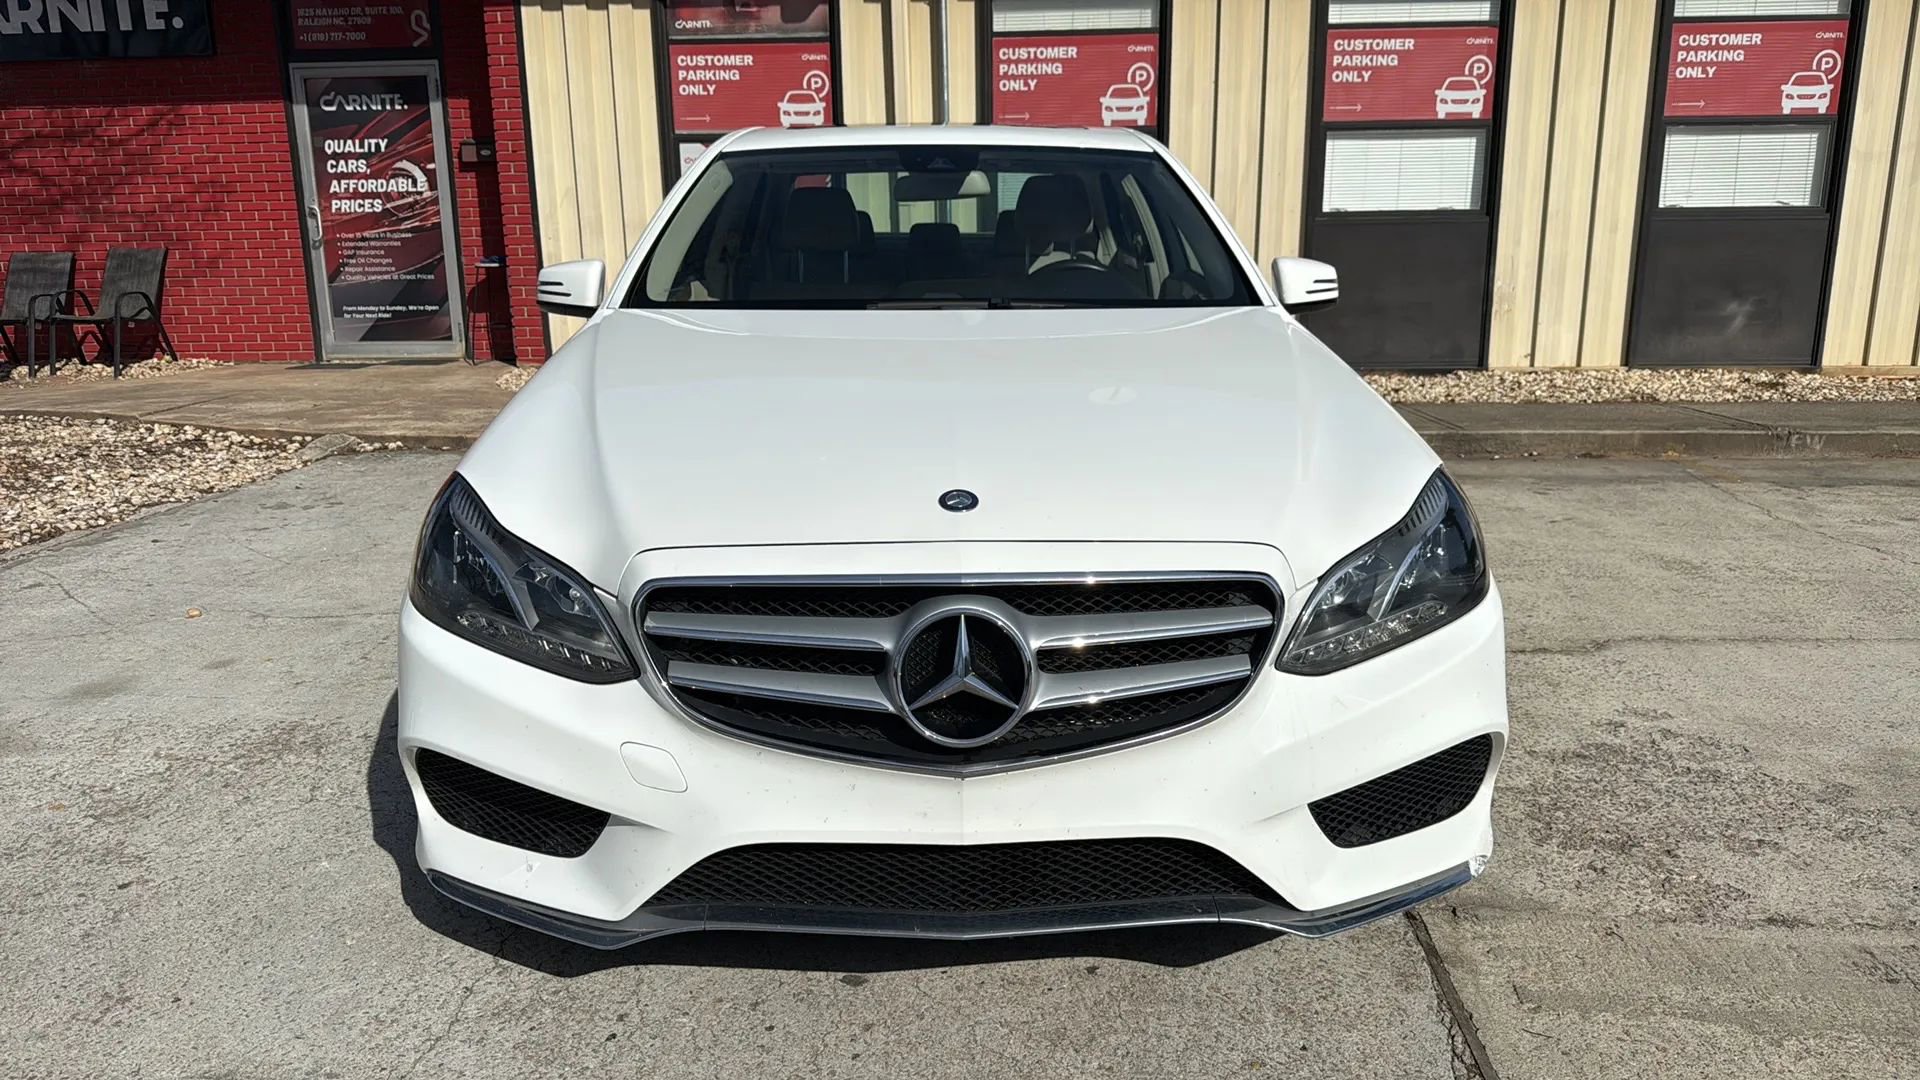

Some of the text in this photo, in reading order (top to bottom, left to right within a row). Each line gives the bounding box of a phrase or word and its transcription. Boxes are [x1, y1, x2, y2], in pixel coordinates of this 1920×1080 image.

[364, 6, 388, 15] SUITE
[298, 17, 332, 26] RALEIGH
[1334, 38, 1415, 51] CUSTOMER
[1679, 33, 1762, 46] CUSTOMER
[999, 46, 1078, 60] CUSTOMER
[1677, 49, 1745, 62] PARKING
[677, 54, 754, 66] CUSTOMER
[1333, 54, 1399, 67] PARKING
[1821, 57, 1834, 71] P
[678, 69, 740, 81] PARKING
[999, 63, 1063, 76] PARKING
[1473, 63, 1485, 76] P
[1675, 66, 1717, 78] ONLY
[1135, 71, 1147, 84] P
[1332, 70, 1372, 83] ONLY
[679, 84, 716, 96] ONLY
[810, 77, 822, 90] P
[999, 79, 1038, 91] ONLY
[320, 91, 408, 111] CARNITE.
[324, 139, 388, 154] QUALITY
[327, 159, 370, 174] CARS,
[329, 178, 426, 193] AFFORDABLE
[332, 199, 383, 213] PRICES
